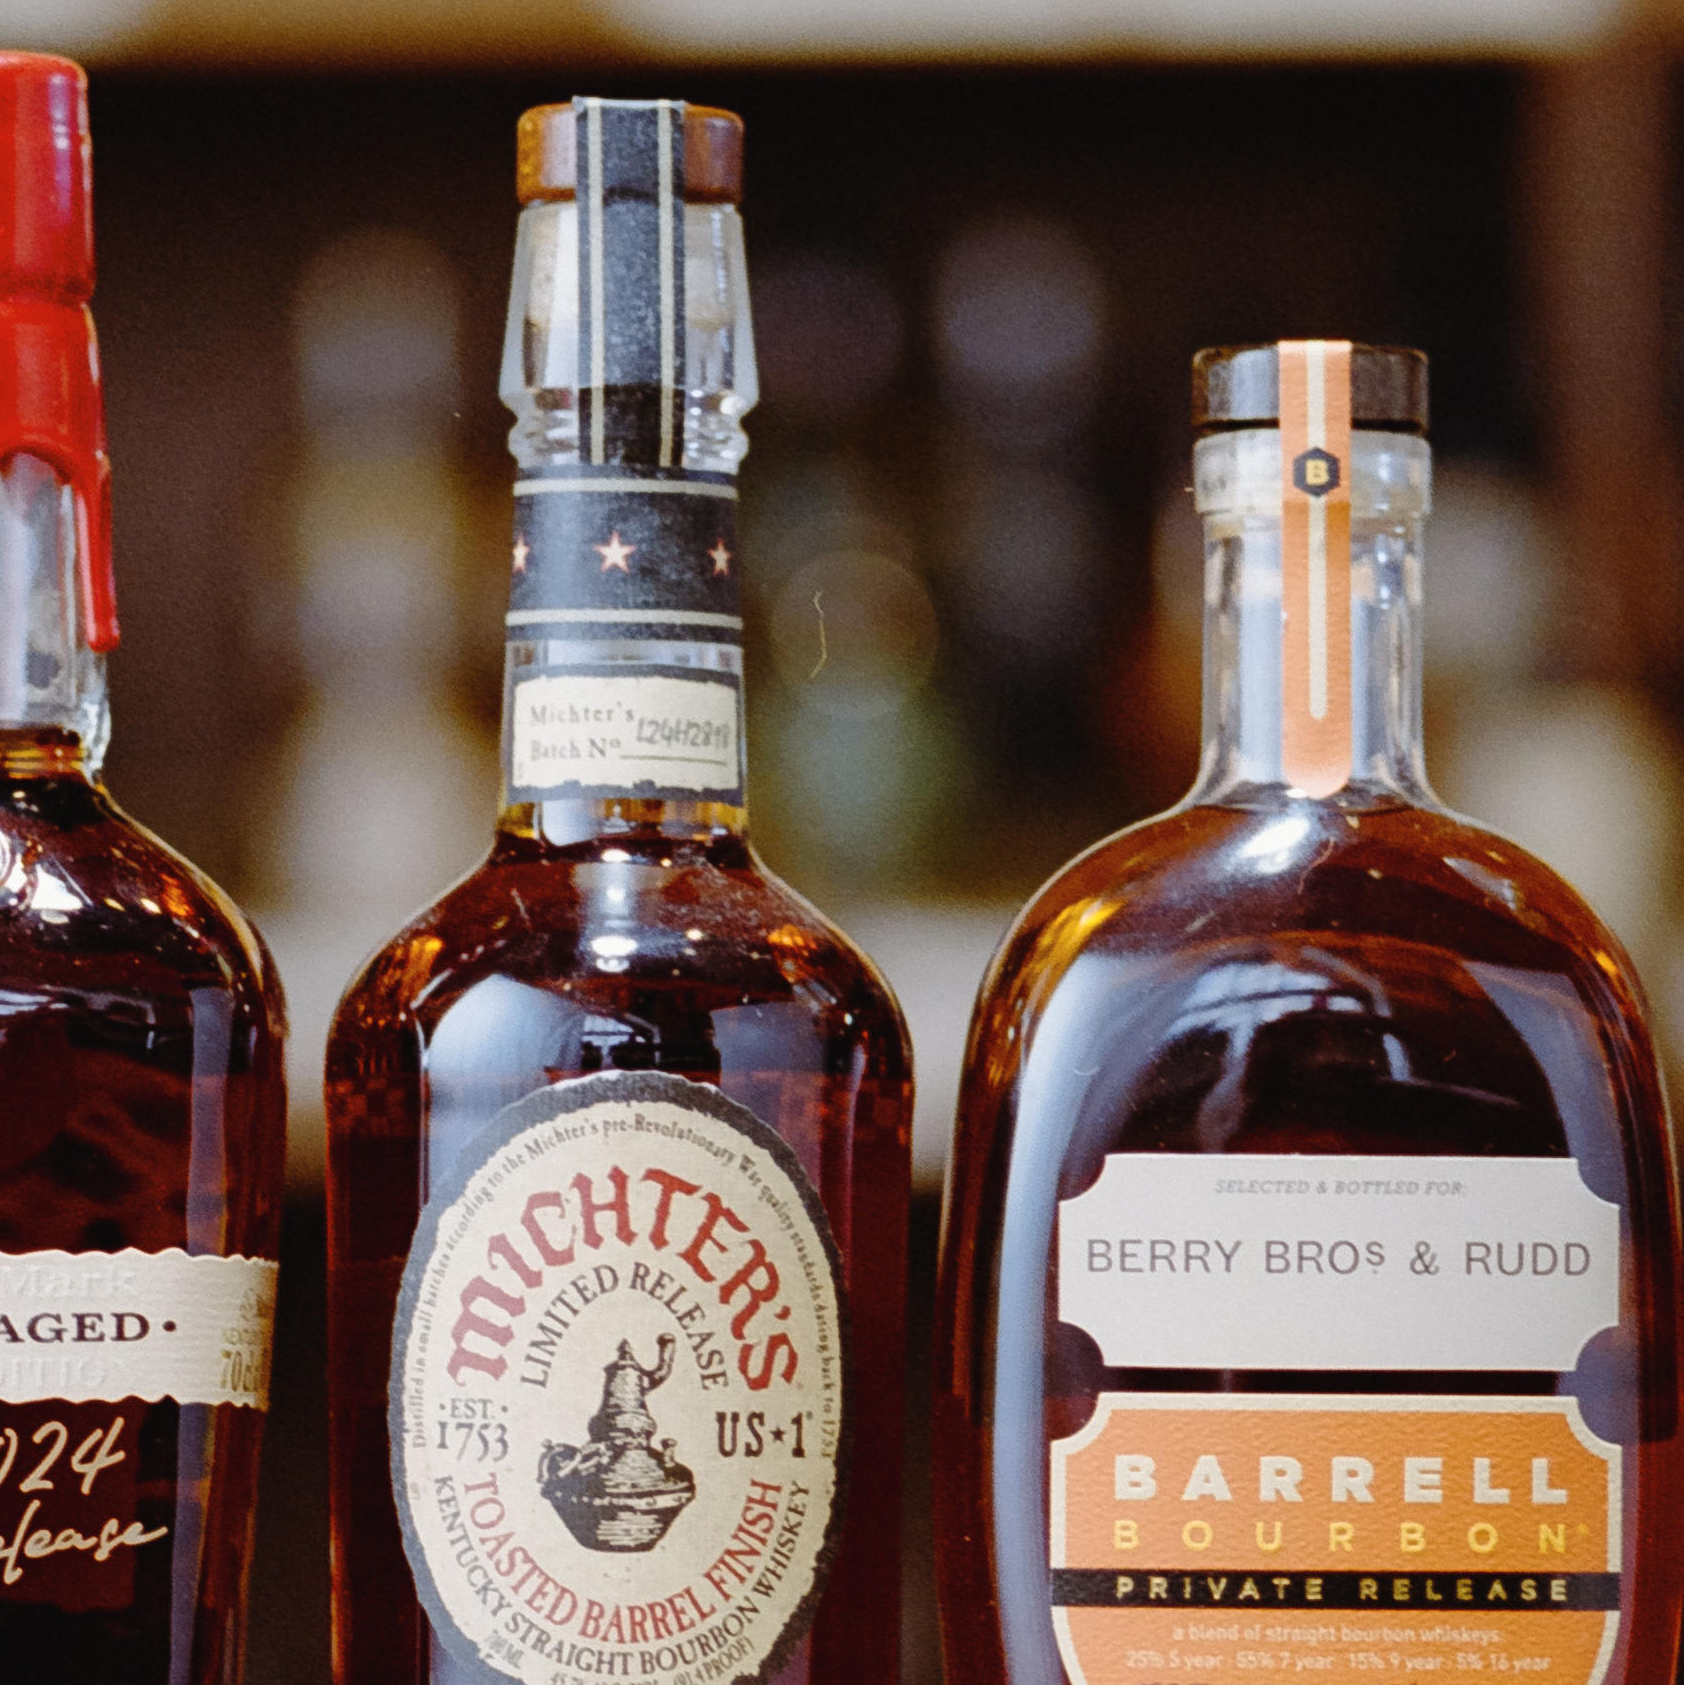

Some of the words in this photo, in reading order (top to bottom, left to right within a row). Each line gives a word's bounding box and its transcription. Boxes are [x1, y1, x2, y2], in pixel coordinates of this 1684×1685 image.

[1304, 458, 1330, 487] B
[531, 701, 634, 725] Michter's
[1214, 1178, 1313, 1196] SELECTED
[1333, 1179, 1421, 1197] BOTTLED
[446, 1164, 799, 1392] MICHTER'S
[1086, 1239, 1243, 1274] BERRY
[1408, 1240, 1441, 1277] &
[1465, 1241, 1592, 1277] RUDD
[411, 1376, 427, 1449] Distilled
[444, 1187, 495, 1251] according
[487, 1171, 505, 1189] to
[502, 1153, 527, 1174] the
[523, 1116, 599, 1161] Michter's
[520, 1263, 620, 1390] LIMITED
[629, 1261, 731, 1392] RELEASE
[437, 1421, 509, 1463] 1753
[1114, 1453, 1569, 1505] BARRELL
[1113, 1519, 1567, 1554] BOURBON
[434, 1474, 513, 1618] KENTUCKY
[504, 1611, 635, 1676] STRAIGHT
[640, 1595, 761, 1675] BOURBON
[752, 1480, 810, 1599] WHISKEY
[464, 1472, 579, 1627] TOASTED
[577, 1585, 718, 1645] BARREL
[703, 1478, 783, 1603] FINISH
[1114, 1575, 1325, 1602] PRIVATE
[1358, 1576, 1569, 1603] RELEASE
[1172, 1627, 1184, 1641] a
[1187, 1623, 1240, 1642] blend
[1243, 1624, 1262, 1641] of
[1264, 1624, 1338, 1646] straight
[1340, 1624, 1415, 1643] bourbon
